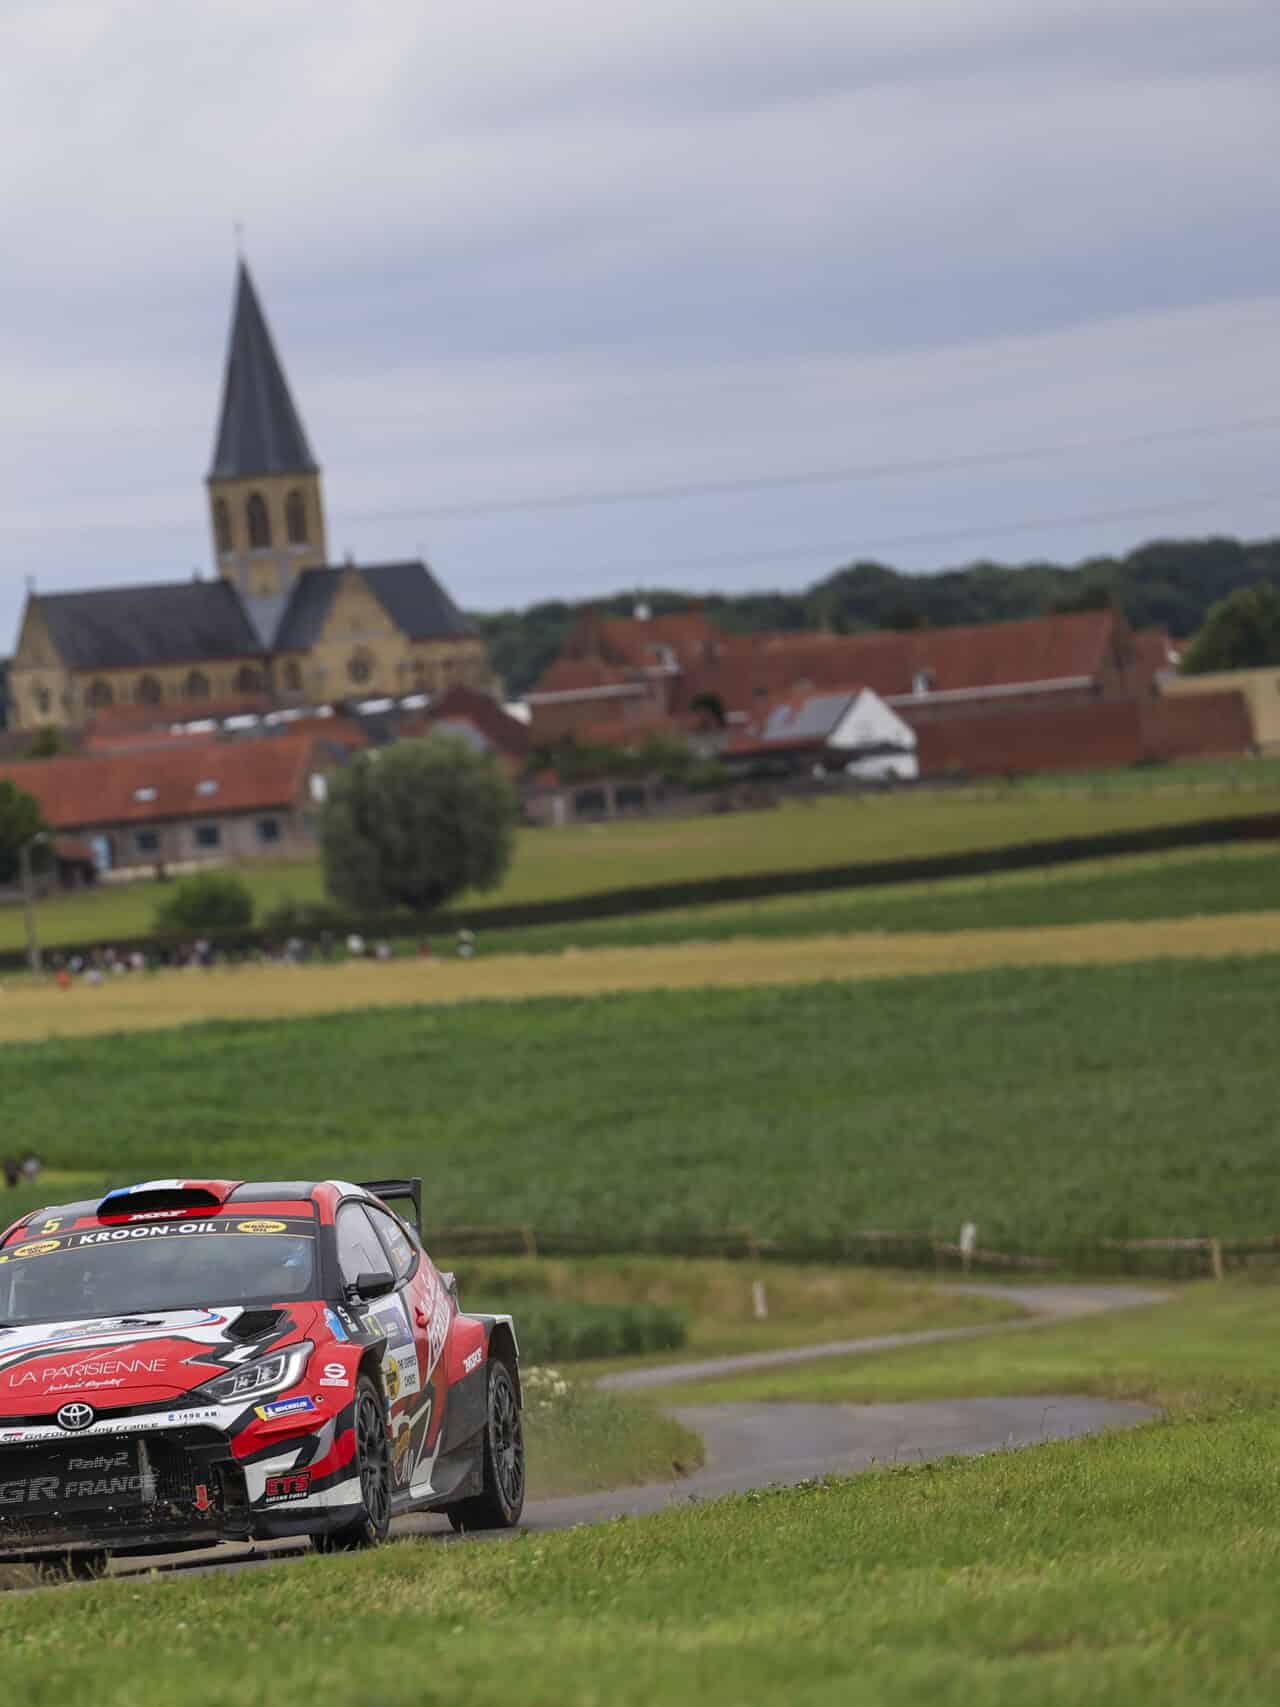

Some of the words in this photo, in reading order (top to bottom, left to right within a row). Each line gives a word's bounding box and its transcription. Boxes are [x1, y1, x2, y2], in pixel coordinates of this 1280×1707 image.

[41, 1217, 64, 1234] 5
[79, 1223, 216, 1245] KROON-OIL
[8, 1370, 37, 1388] LA
[42, 1358, 168, 1381] PARISIENNE
[68, 1451, 129, 1472] Rally2
[266, 1475, 309, 1496] ETS
